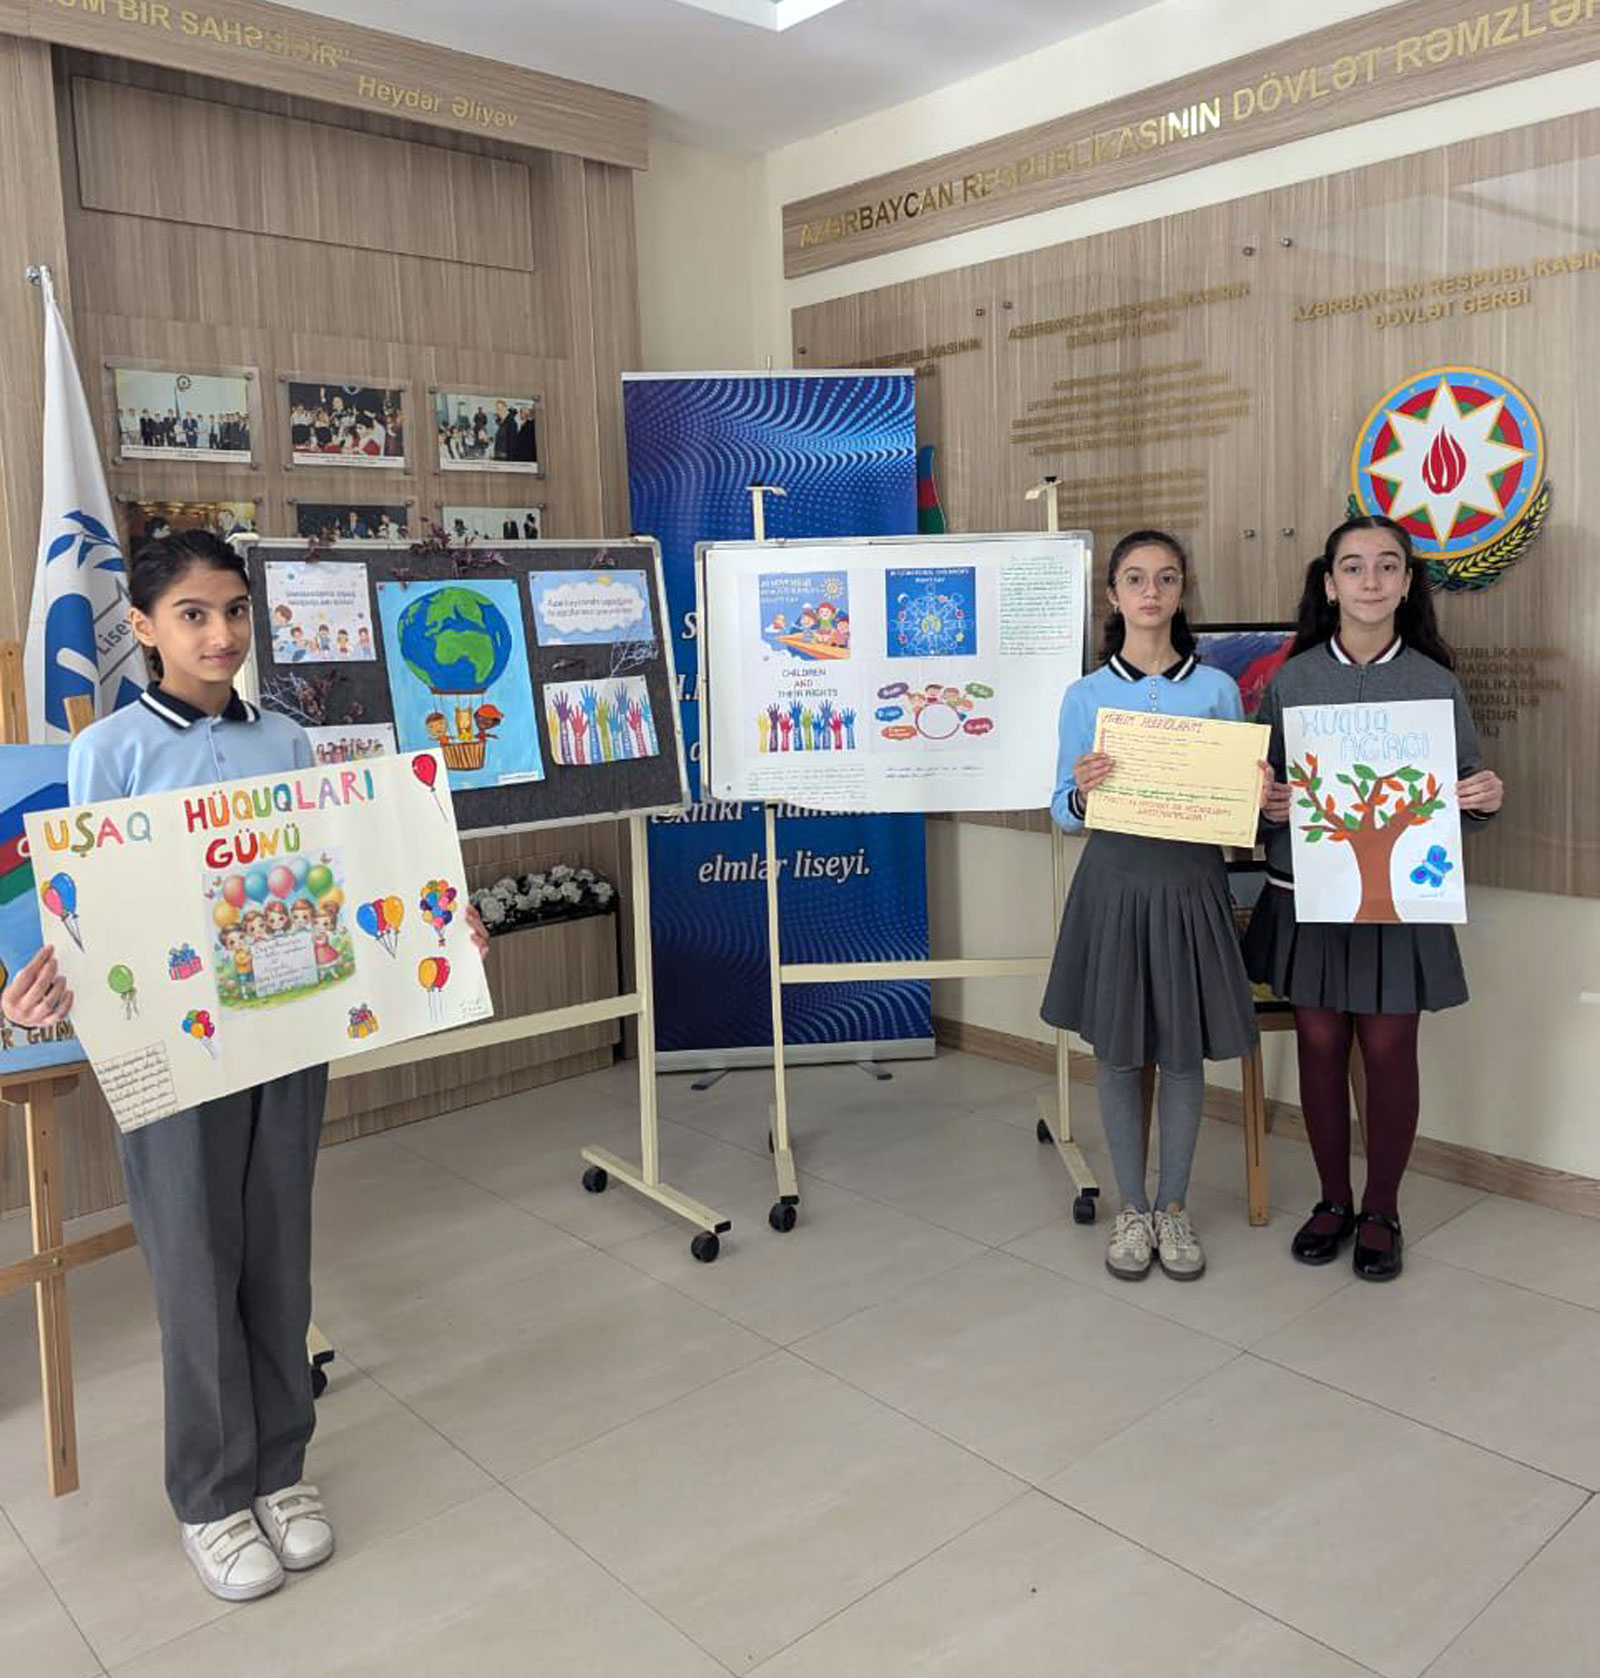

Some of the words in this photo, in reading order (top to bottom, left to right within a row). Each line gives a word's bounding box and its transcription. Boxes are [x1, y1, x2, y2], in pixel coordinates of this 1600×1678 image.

[358, 75, 440, 112] Heydər
[1233, 47, 1384, 121] DÖVLƏT
[44, 811, 152, 858] UŞAQ
[184, 768, 375, 833] HÜQUQLARI
[205, 822, 301, 869] GÜNÜ
[793, 848, 871, 884] liseyi.
